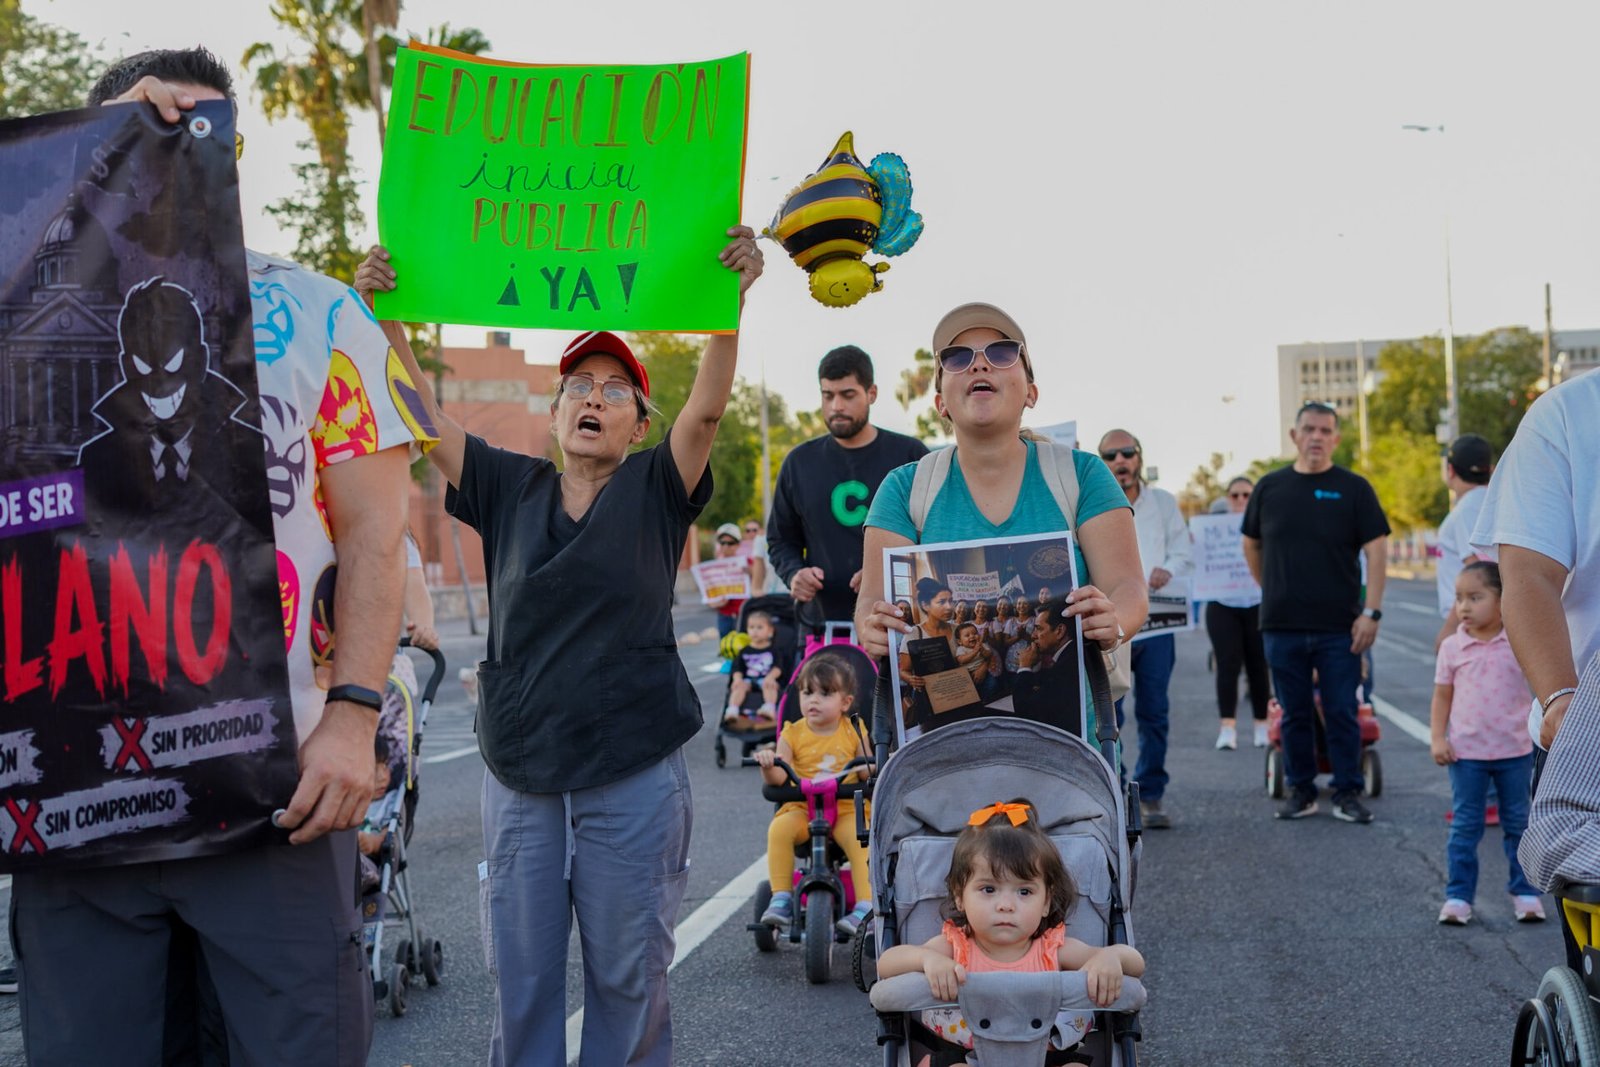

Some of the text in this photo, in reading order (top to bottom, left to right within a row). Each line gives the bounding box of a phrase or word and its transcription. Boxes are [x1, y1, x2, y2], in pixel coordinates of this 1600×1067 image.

[408, 60, 721, 148] EDUCACIÓN
[472, 198, 648, 252] PÚBLICA
[28, 482, 74, 522] SER
[152, 713, 263, 754] SIN PRIORIDAD
[45, 788, 176, 836] SIN COMPROMISO
